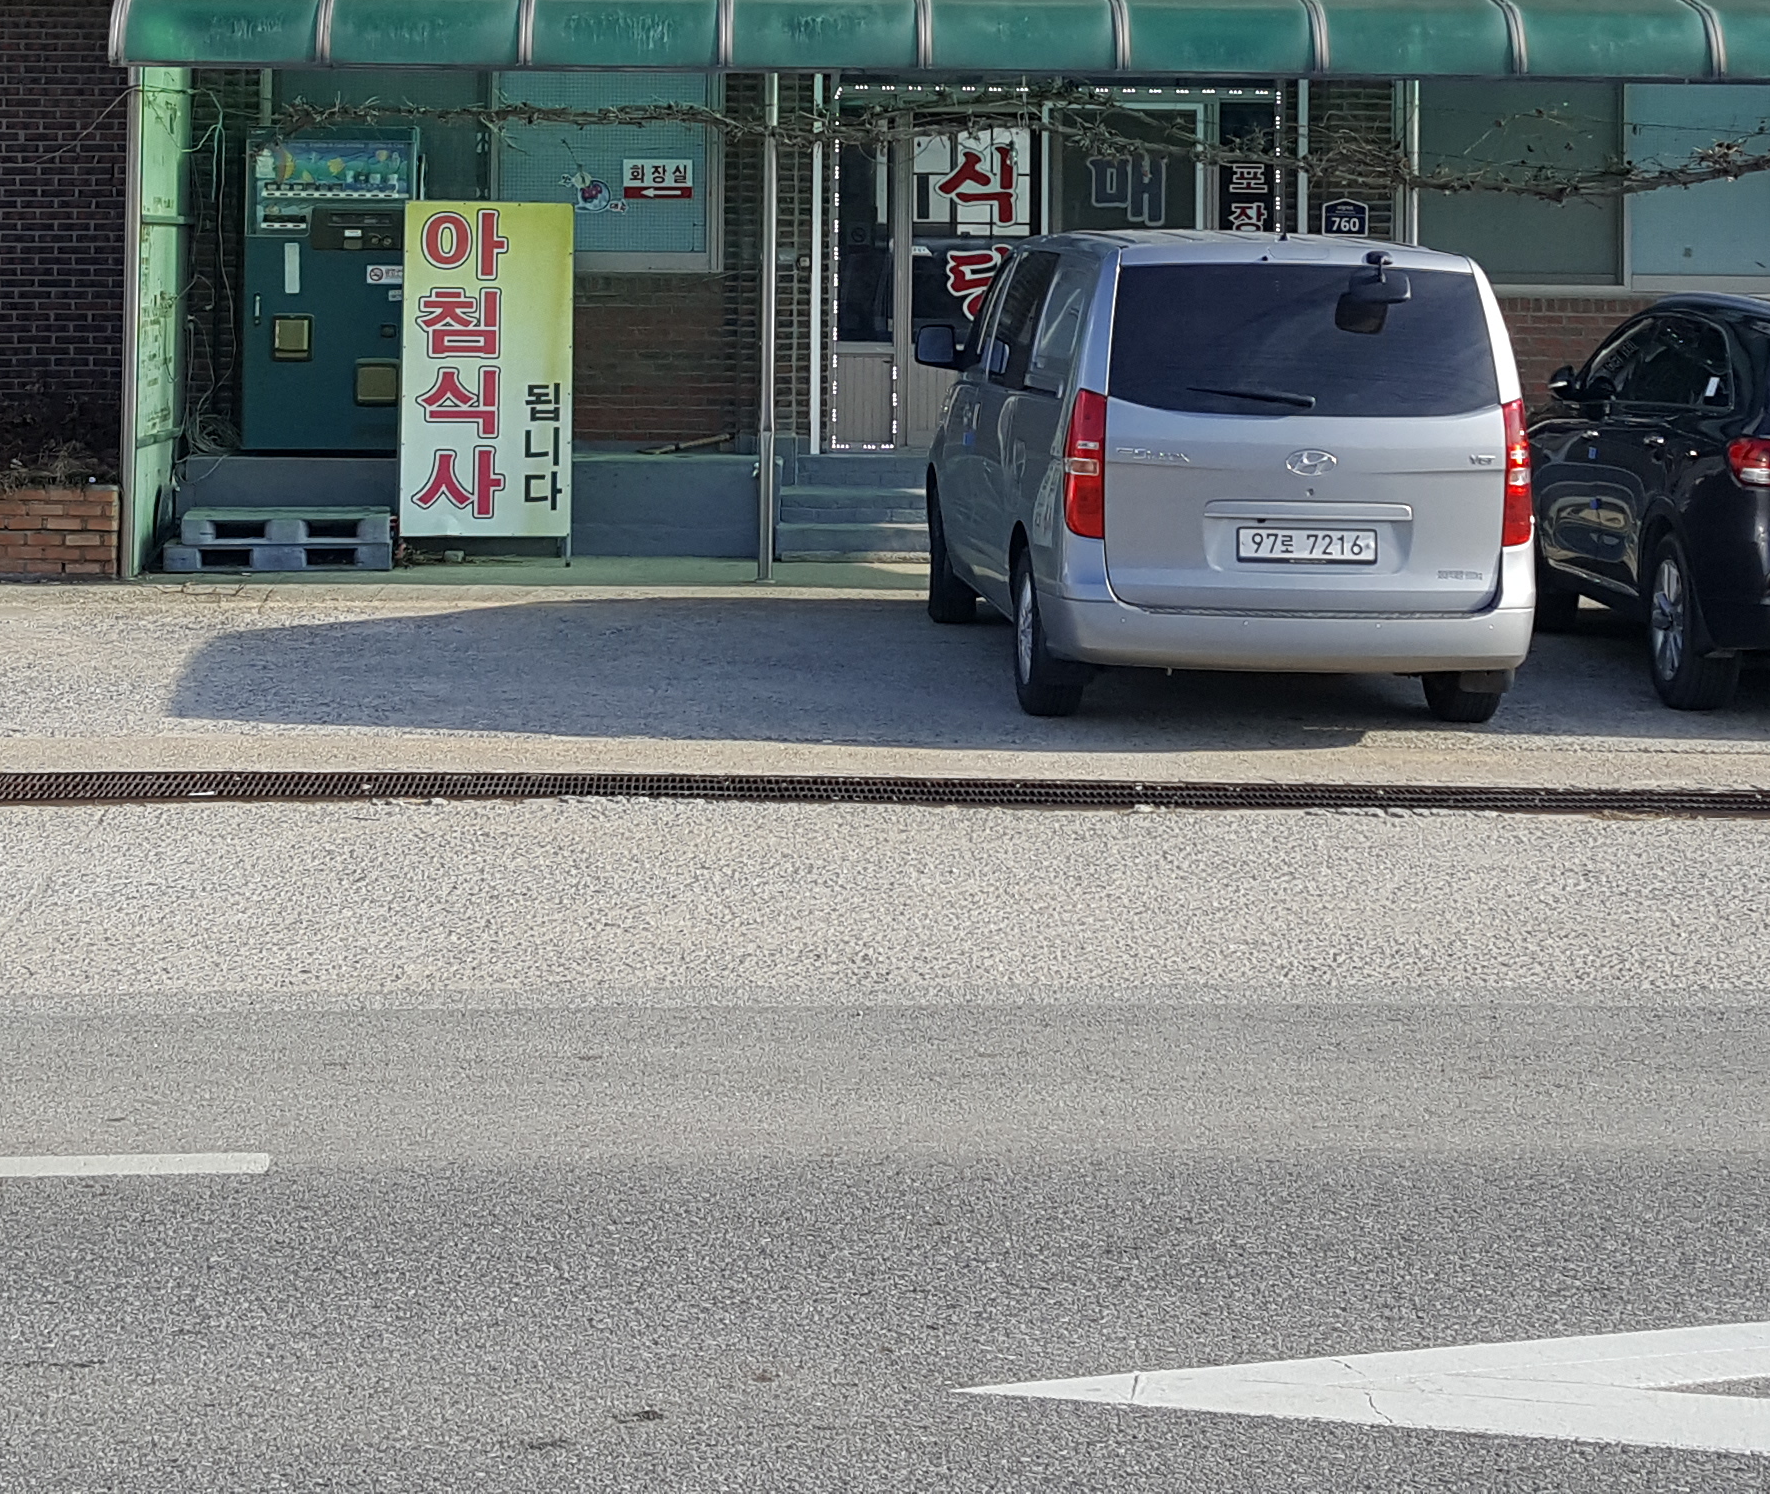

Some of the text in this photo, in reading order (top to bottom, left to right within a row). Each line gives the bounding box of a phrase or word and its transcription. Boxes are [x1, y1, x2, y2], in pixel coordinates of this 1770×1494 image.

[629, 164, 687, 184] 화장실
[1331, 217, 1360, 232] 760
[411, 208, 509, 519] 아침식사
[524, 382, 563, 511] 됩니다
[1251, 533, 1364, 556] 97로 7216
